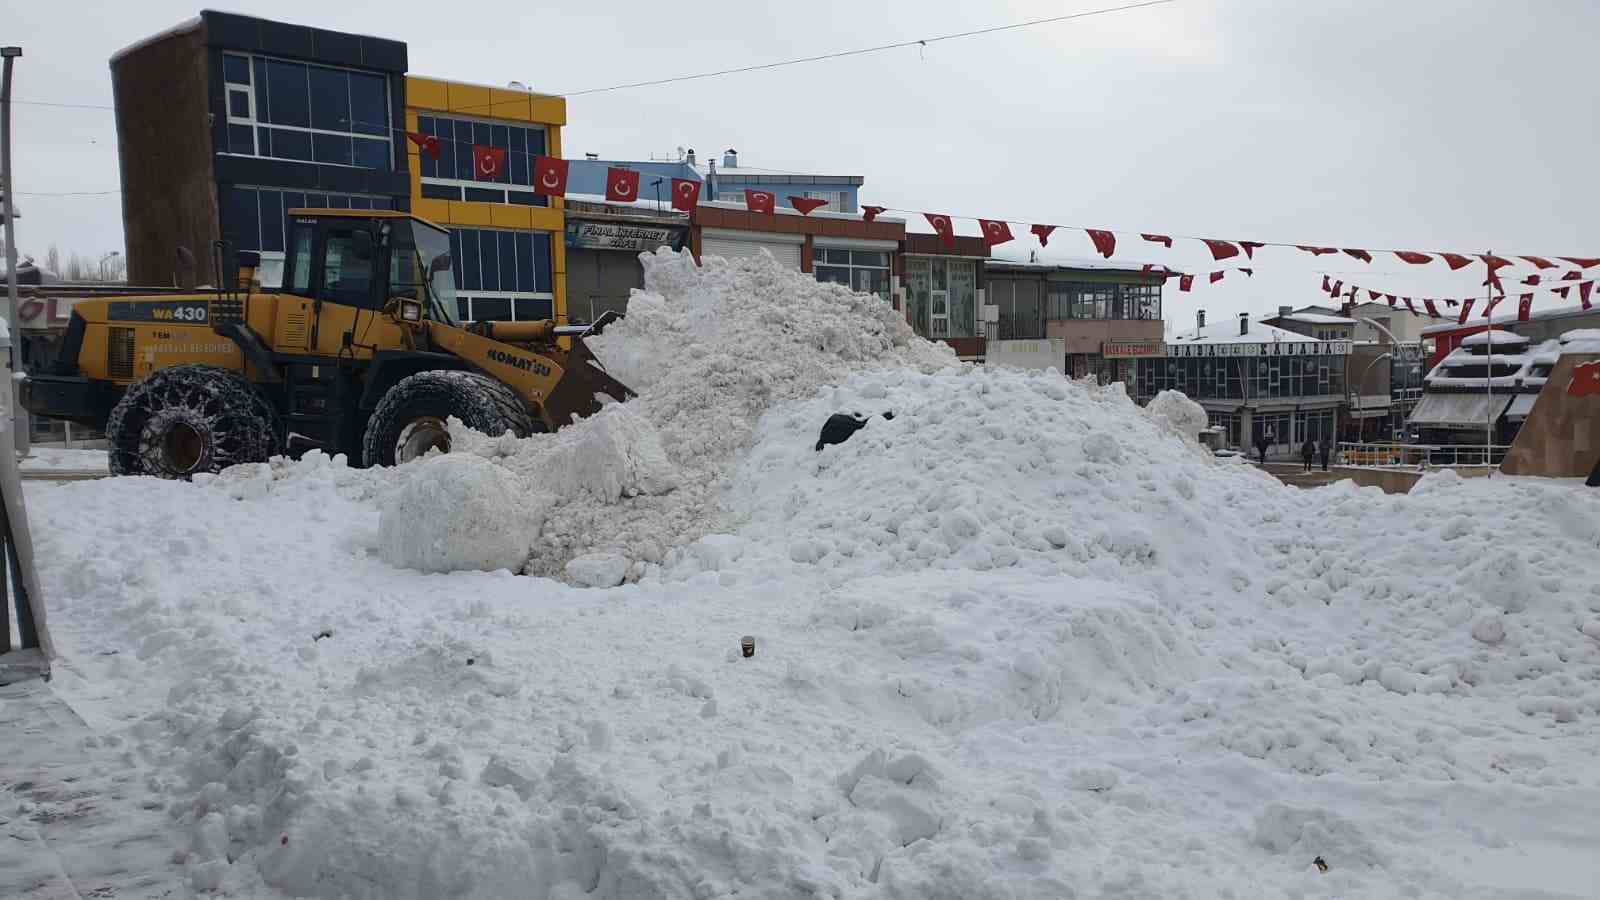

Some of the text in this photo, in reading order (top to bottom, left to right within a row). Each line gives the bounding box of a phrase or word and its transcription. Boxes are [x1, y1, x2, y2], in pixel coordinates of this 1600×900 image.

[583, 224, 613, 237] FINAL
[607, 238, 637, 249] CAFE
[152, 306, 207, 321] WA430
[486, 348, 552, 377] KOMATSU
